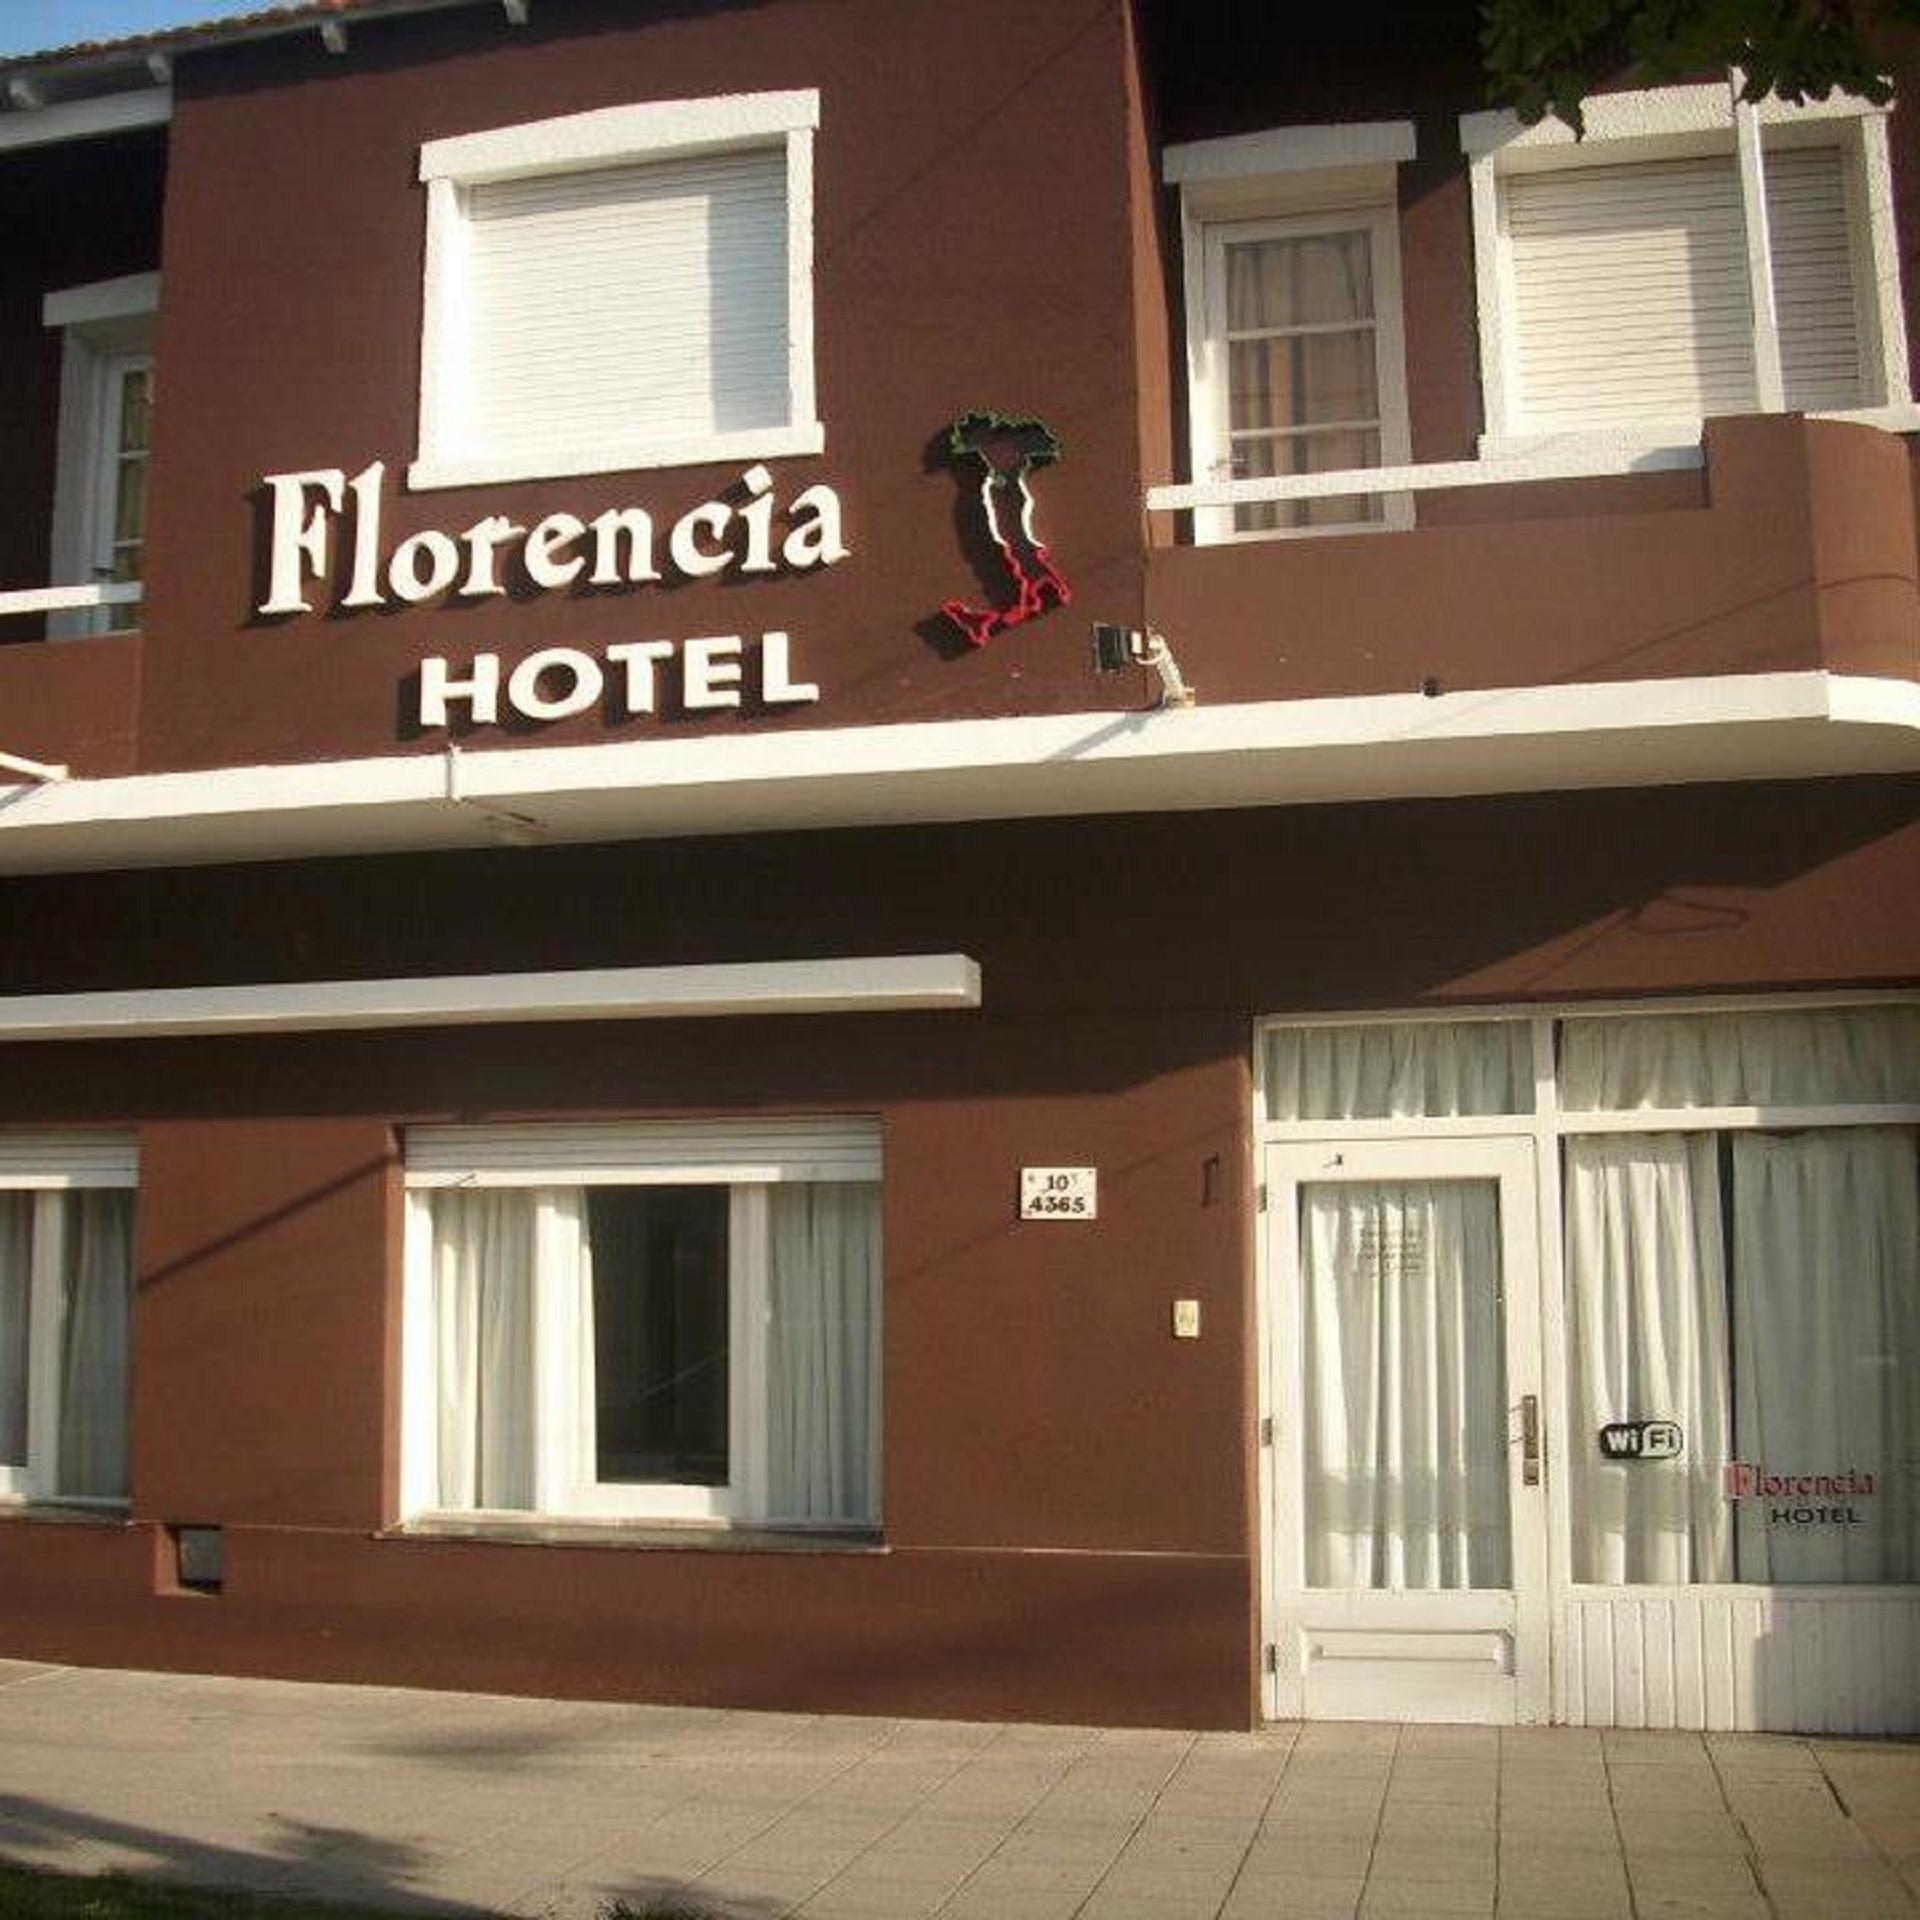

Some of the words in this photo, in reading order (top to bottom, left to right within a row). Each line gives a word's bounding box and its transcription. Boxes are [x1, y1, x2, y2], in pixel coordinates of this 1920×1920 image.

[258, 460, 852, 616] Florencia
[419, 631, 821, 727] HOTEL
[1726, 1461, 1875, 1498] Florencia
[1772, 1507, 1862, 1524] HOTEL
